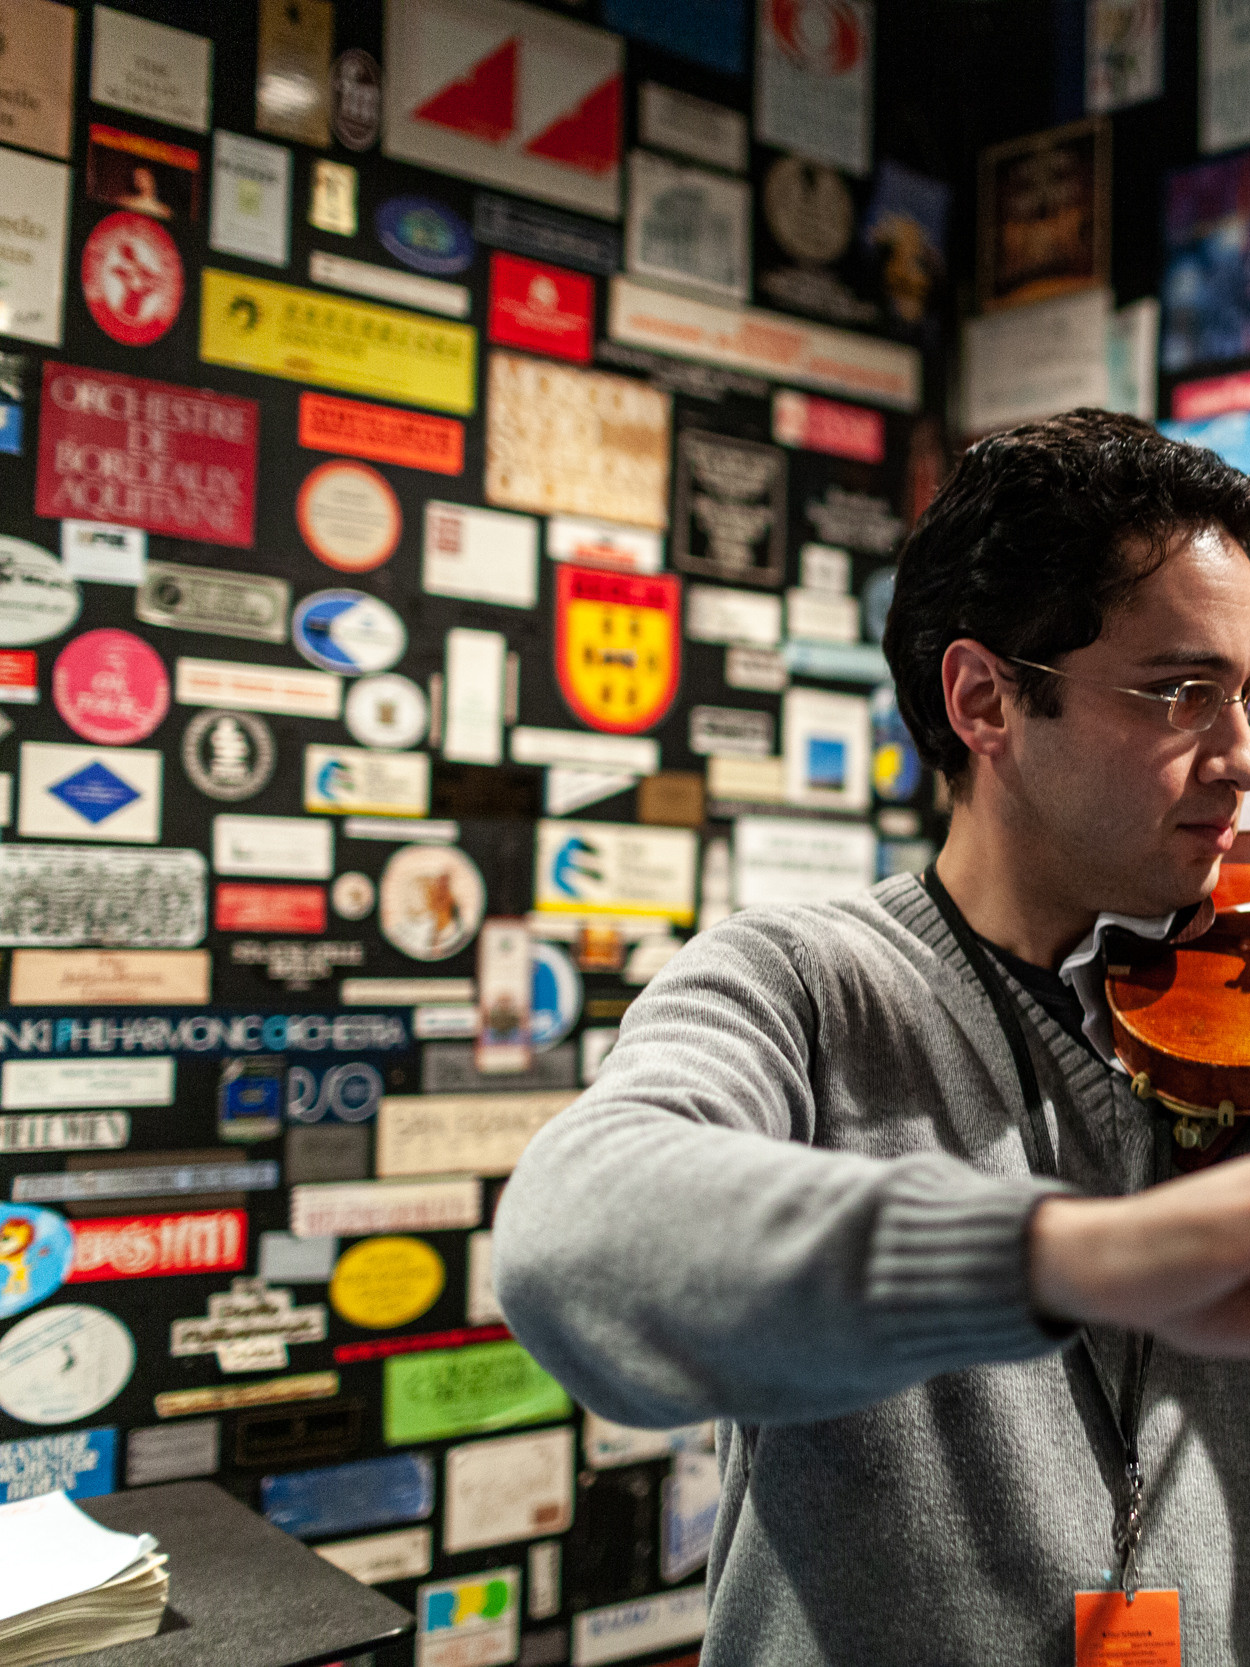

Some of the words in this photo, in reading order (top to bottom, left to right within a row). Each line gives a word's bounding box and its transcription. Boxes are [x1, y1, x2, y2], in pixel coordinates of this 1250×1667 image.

[50, 374, 245, 443] ORCHESTRE
[126, 422, 170, 455] DE
[53, 437, 245, 502] BORDEAUX
[53, 476, 236, 533] AQUITAINE
[54, 1015, 266, 1053] PHILHARMONIC
[261, 1014, 405, 1053] ORCHESTRA
